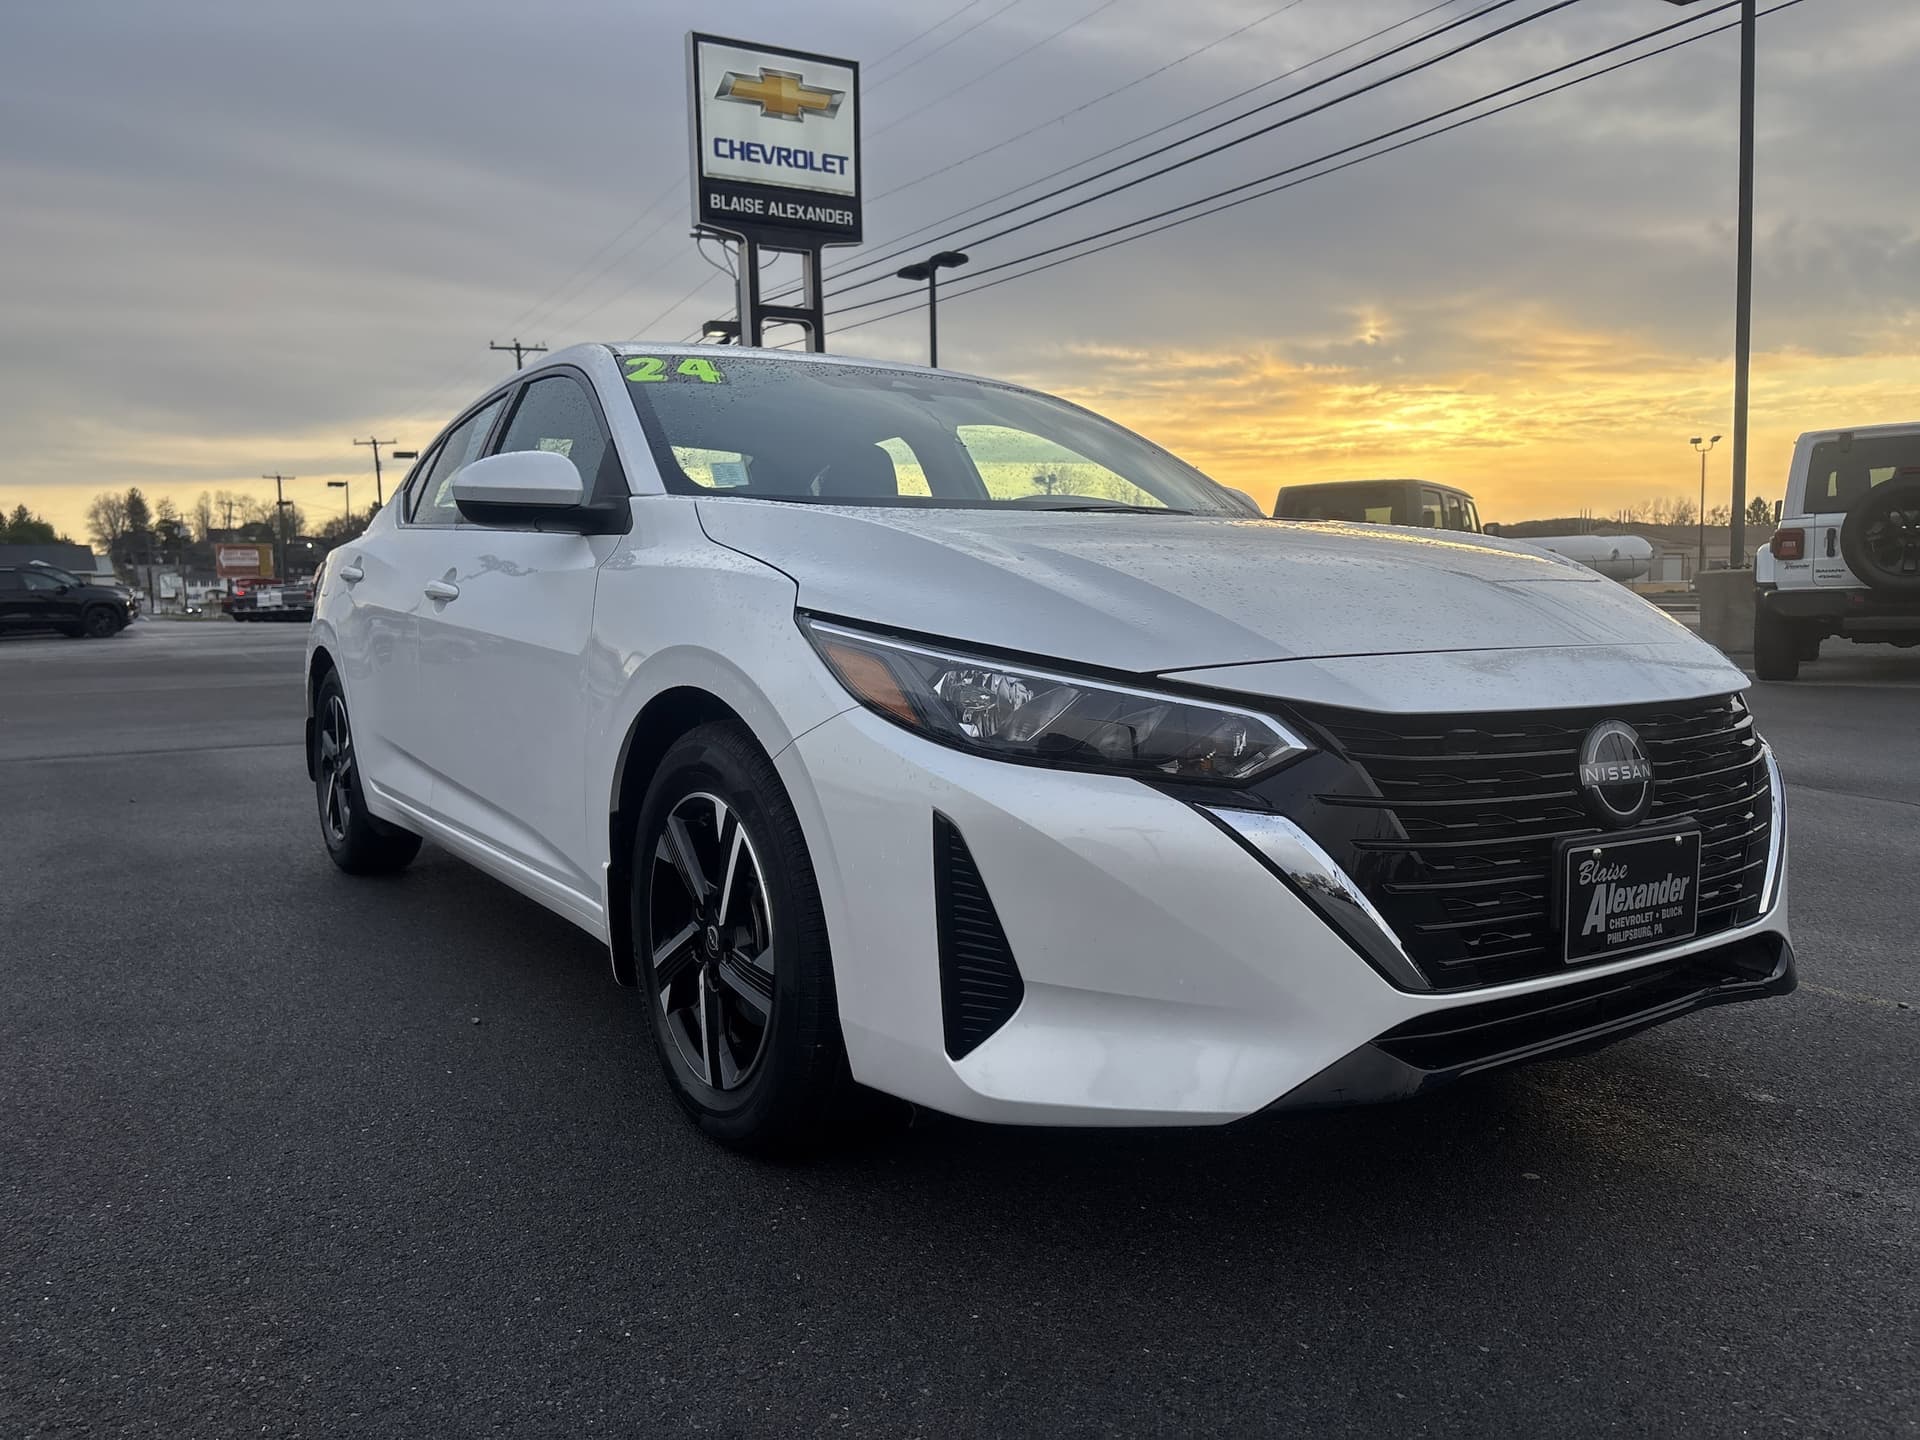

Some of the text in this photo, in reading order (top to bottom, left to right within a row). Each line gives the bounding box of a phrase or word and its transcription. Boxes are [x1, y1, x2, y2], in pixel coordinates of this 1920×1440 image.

[713, 137, 849, 175] CHEVROLET
[710, 193, 854, 226] BLAISE ALEXANDER
[625, 357, 722, 384] 24
[1585, 763, 1651, 782] NISSAN
[1579, 860, 1628, 885] Blaise
[1581, 872, 1691, 936] Alexander
[1609, 905, 1683, 930] CHEVROLET BUICK
[1607, 923, 1663, 944] PHILIPSBURG, PA
